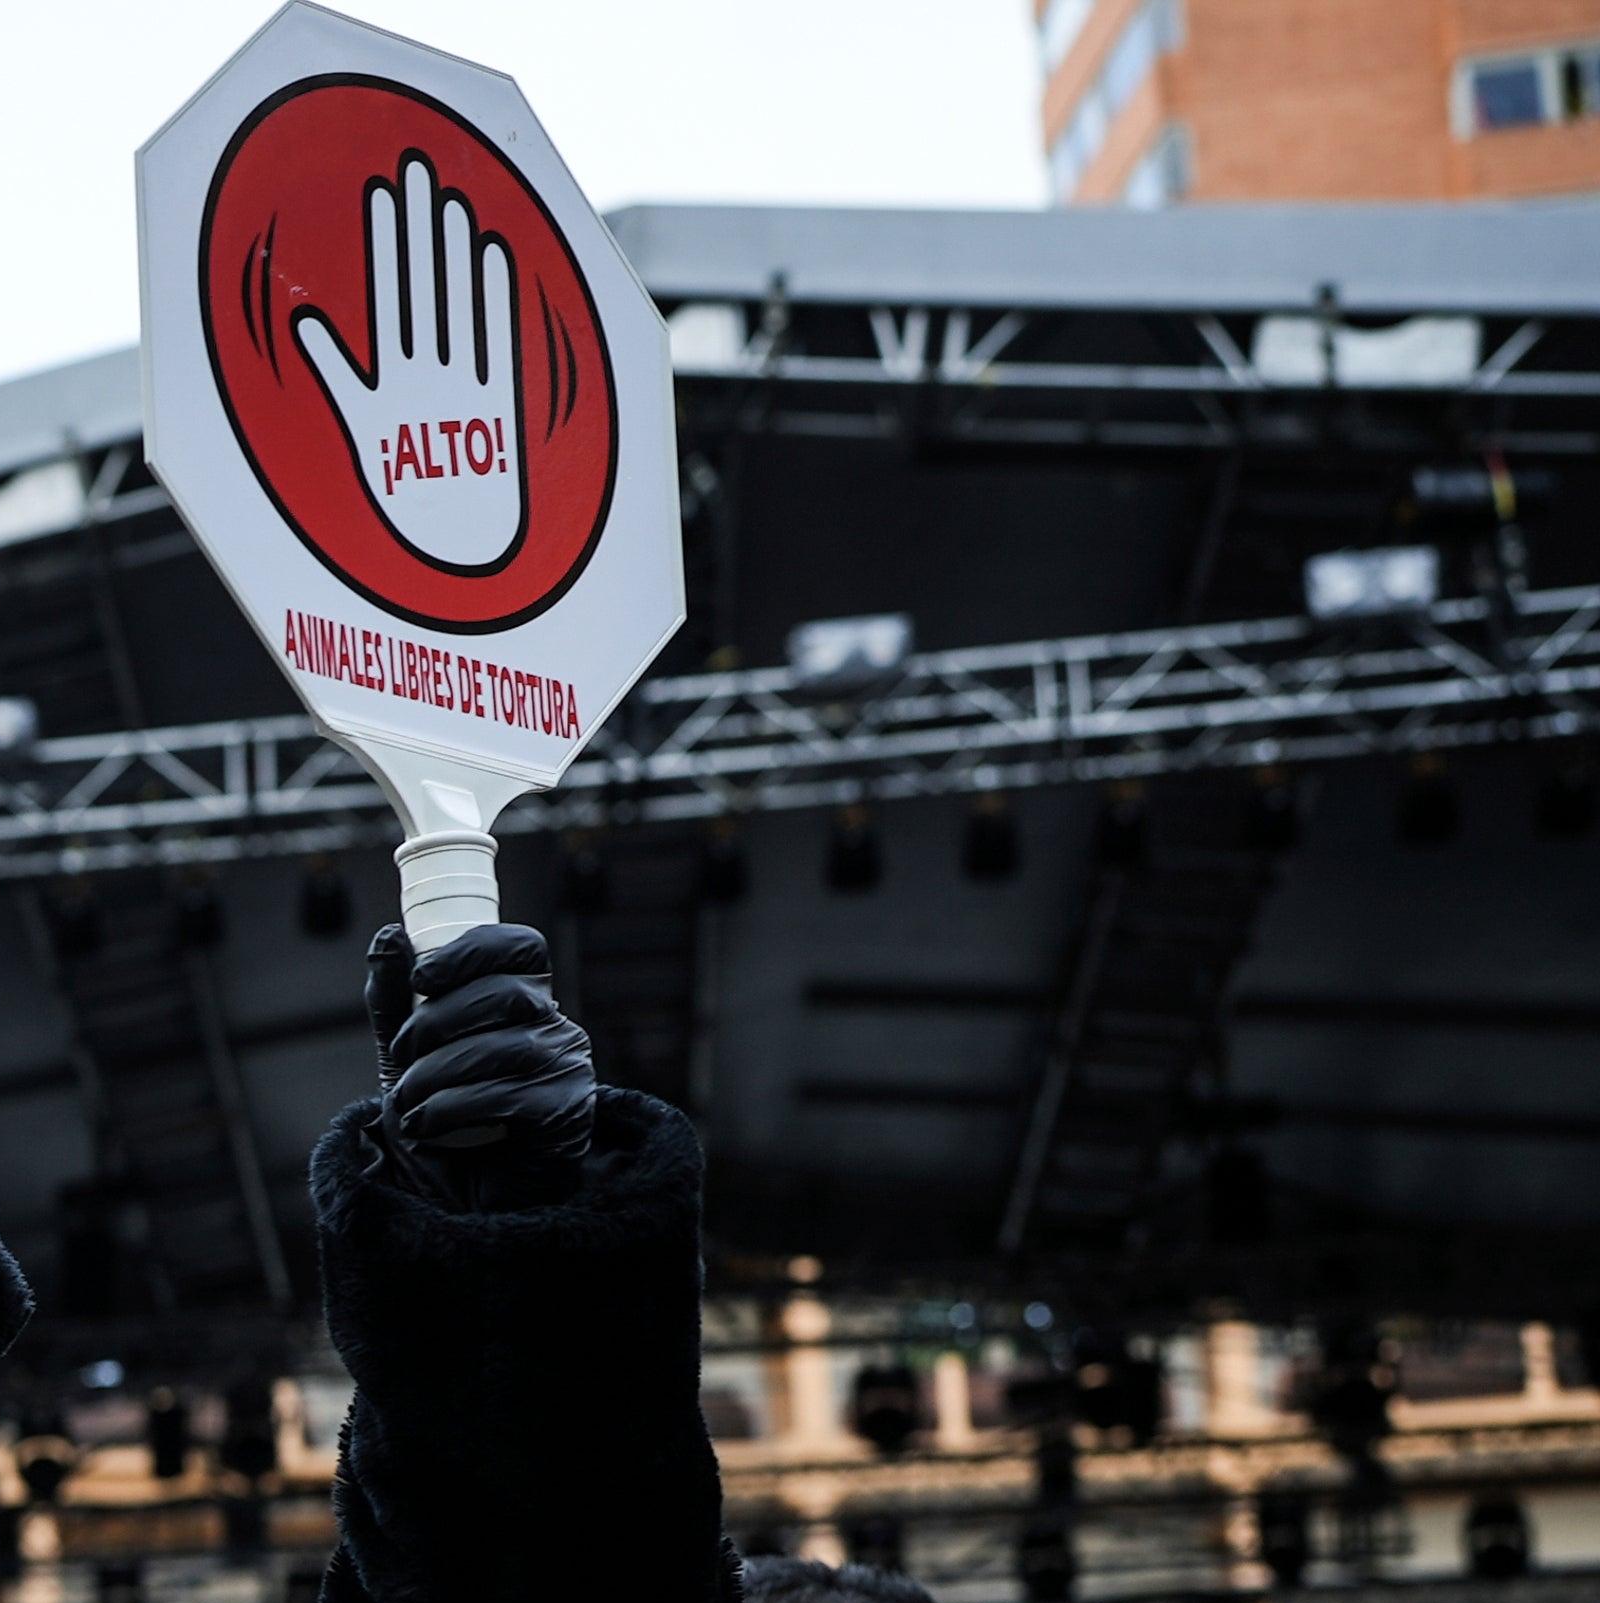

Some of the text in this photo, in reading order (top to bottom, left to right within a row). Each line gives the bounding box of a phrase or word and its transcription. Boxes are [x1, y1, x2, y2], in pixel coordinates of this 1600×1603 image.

[381, 418, 506, 495] ¡ALTO!
[285, 608, 582, 740] ANIMALES LIBRES DE TORTURA
